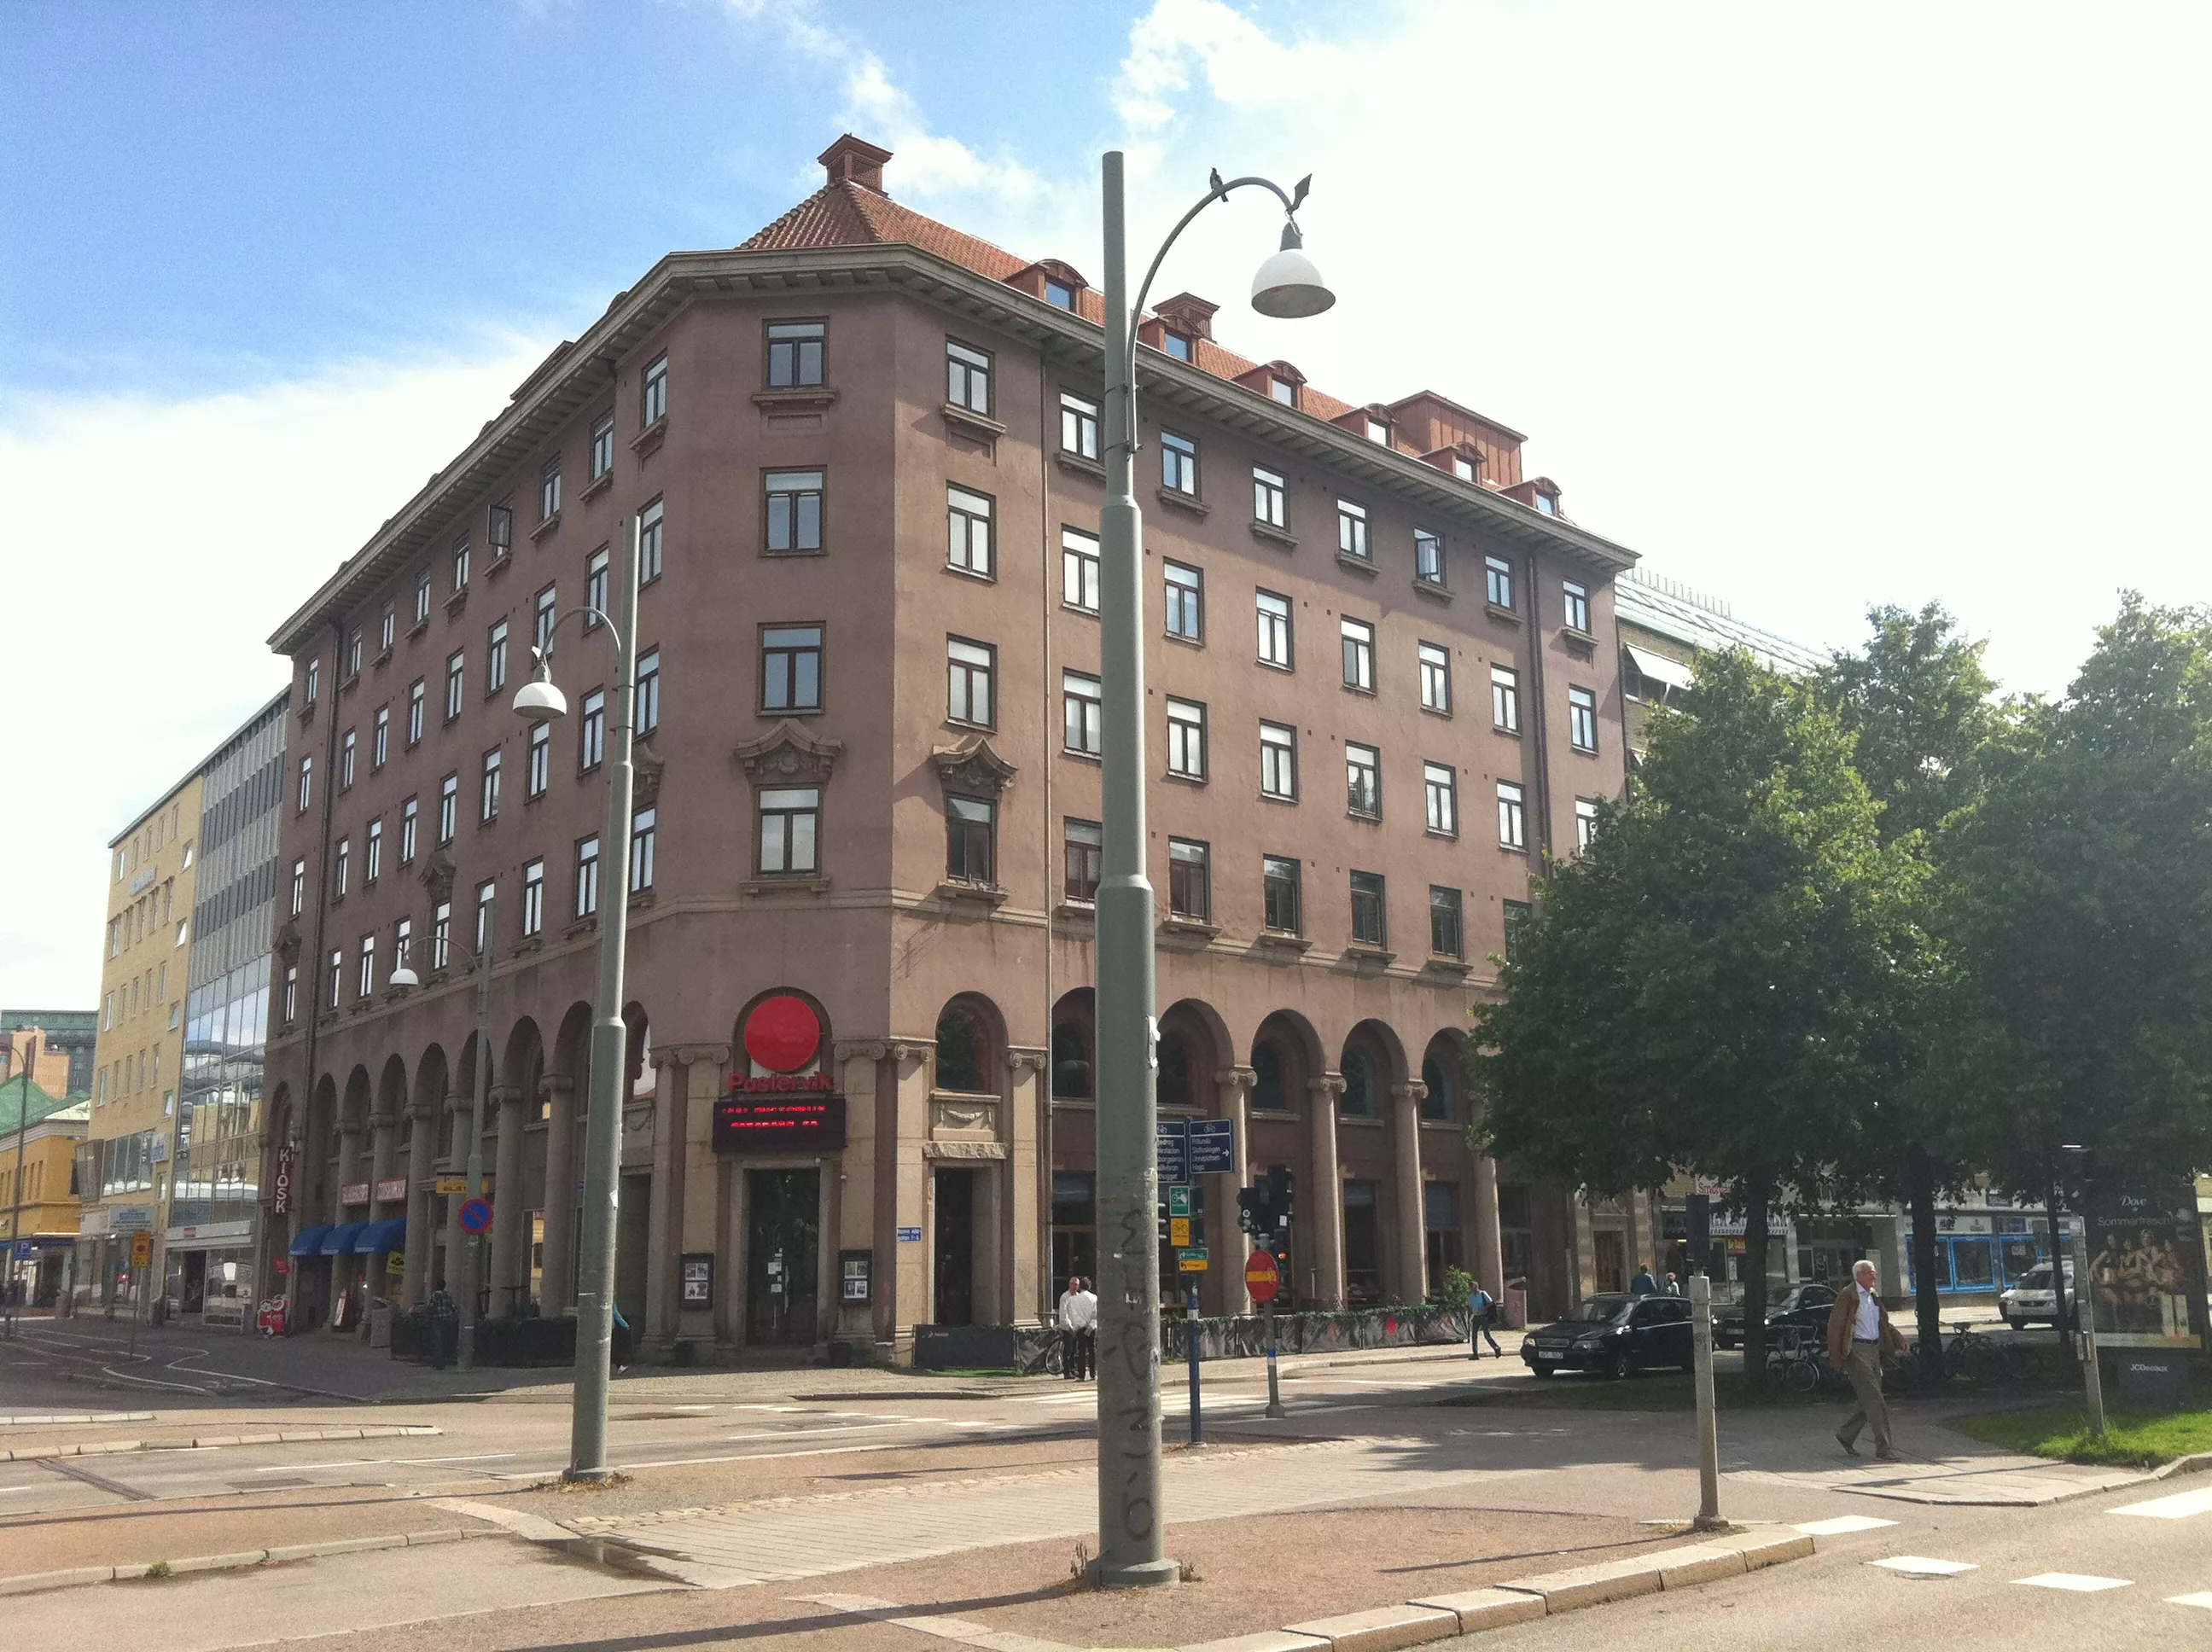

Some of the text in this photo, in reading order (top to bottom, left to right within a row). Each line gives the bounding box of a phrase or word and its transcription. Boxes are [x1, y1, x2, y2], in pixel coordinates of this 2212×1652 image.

[728, 1071, 834, 1092] Pustervik
[275, 1149, 291, 1213] KIOSK
[2120, 1195, 2147, 1207] Dove
[2130, 1364, 2168, 1372] JCDecaux
